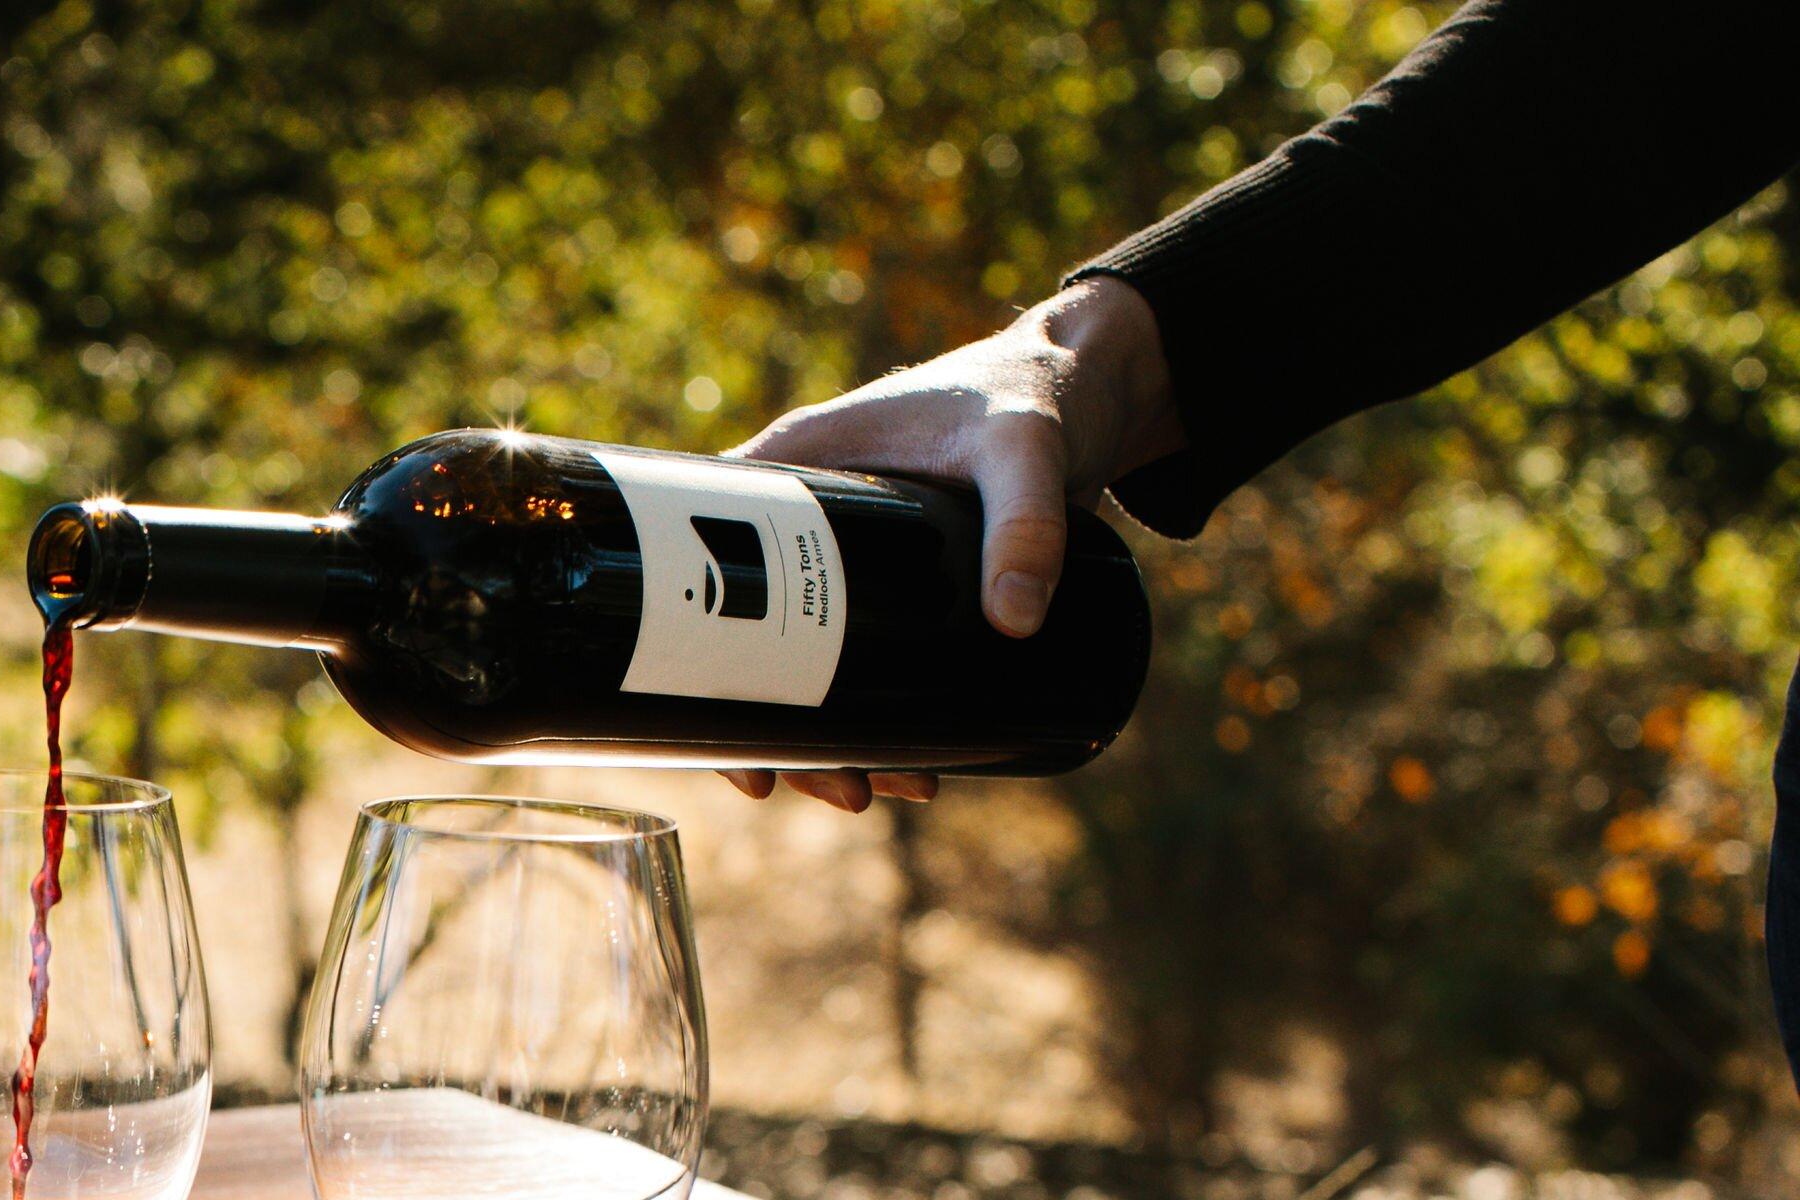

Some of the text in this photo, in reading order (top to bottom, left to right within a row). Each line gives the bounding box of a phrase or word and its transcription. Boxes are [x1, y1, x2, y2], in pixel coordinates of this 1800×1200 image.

[796, 534, 816, 616] Fifty Tons
[809, 529, 829, 627] Medlock Ames
